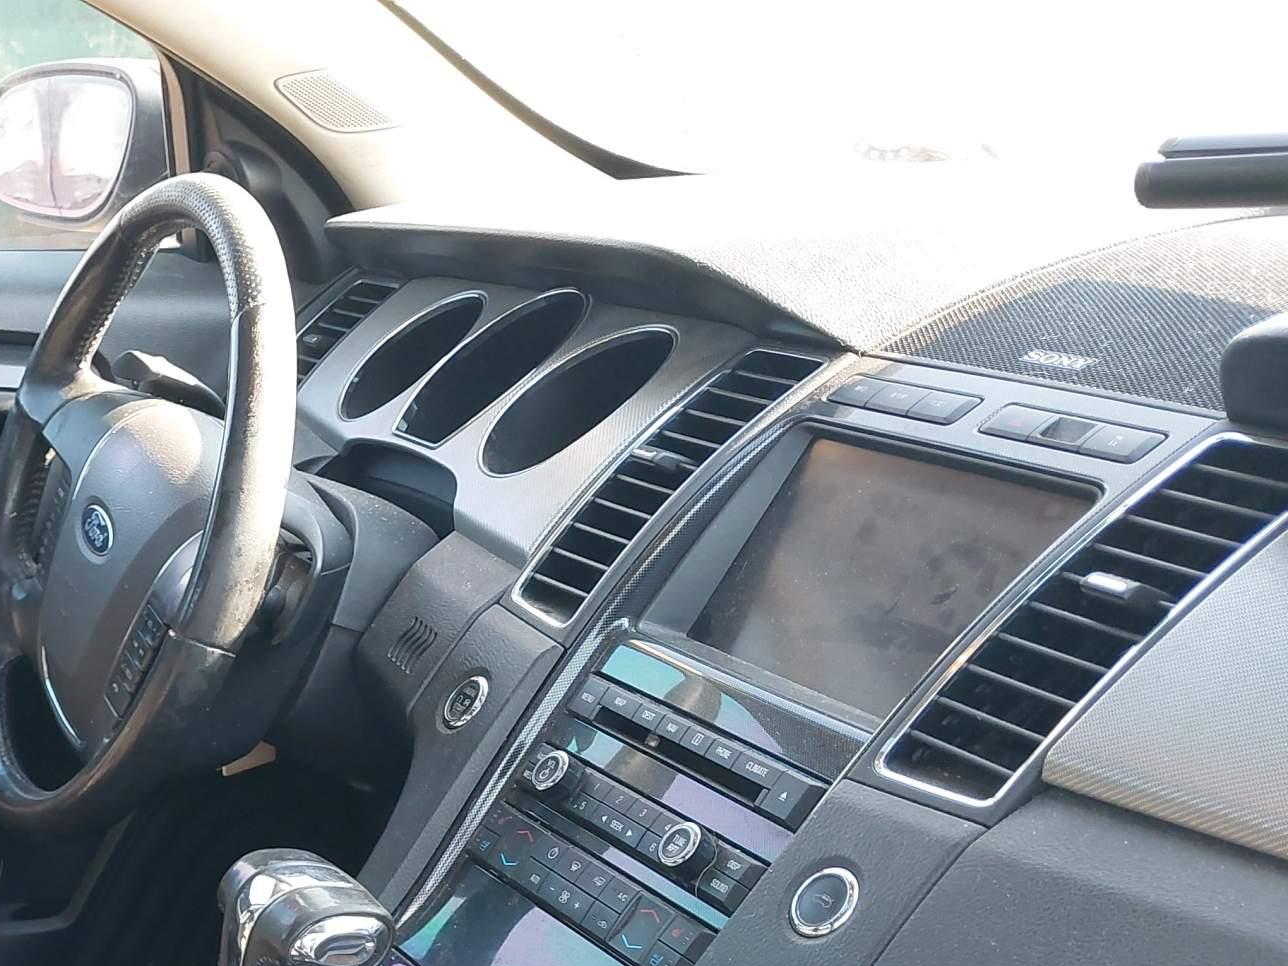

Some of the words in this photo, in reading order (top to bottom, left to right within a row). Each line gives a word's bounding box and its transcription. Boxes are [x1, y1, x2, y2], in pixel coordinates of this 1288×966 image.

[1022, 350, 1097, 370] SONY
[84, 511, 108, 547] Ford
[641, 710, 657, 721] DEST
[715, 745, 733, 760] PHONE
[745, 761, 769, 778] CLIMATE
[593, 783, 601, 791] 1
[578, 801, 587, 810] 5
[615, 795, 624, 804] 2
[639, 808, 648, 817] 3
[610, 819, 625, 832] SEEK
[672, 834, 688, 847] TUNE
[648, 842, 657, 852] 6
[726, 859, 742, 871] DISP
[710, 878, 729, 893] SOUND
